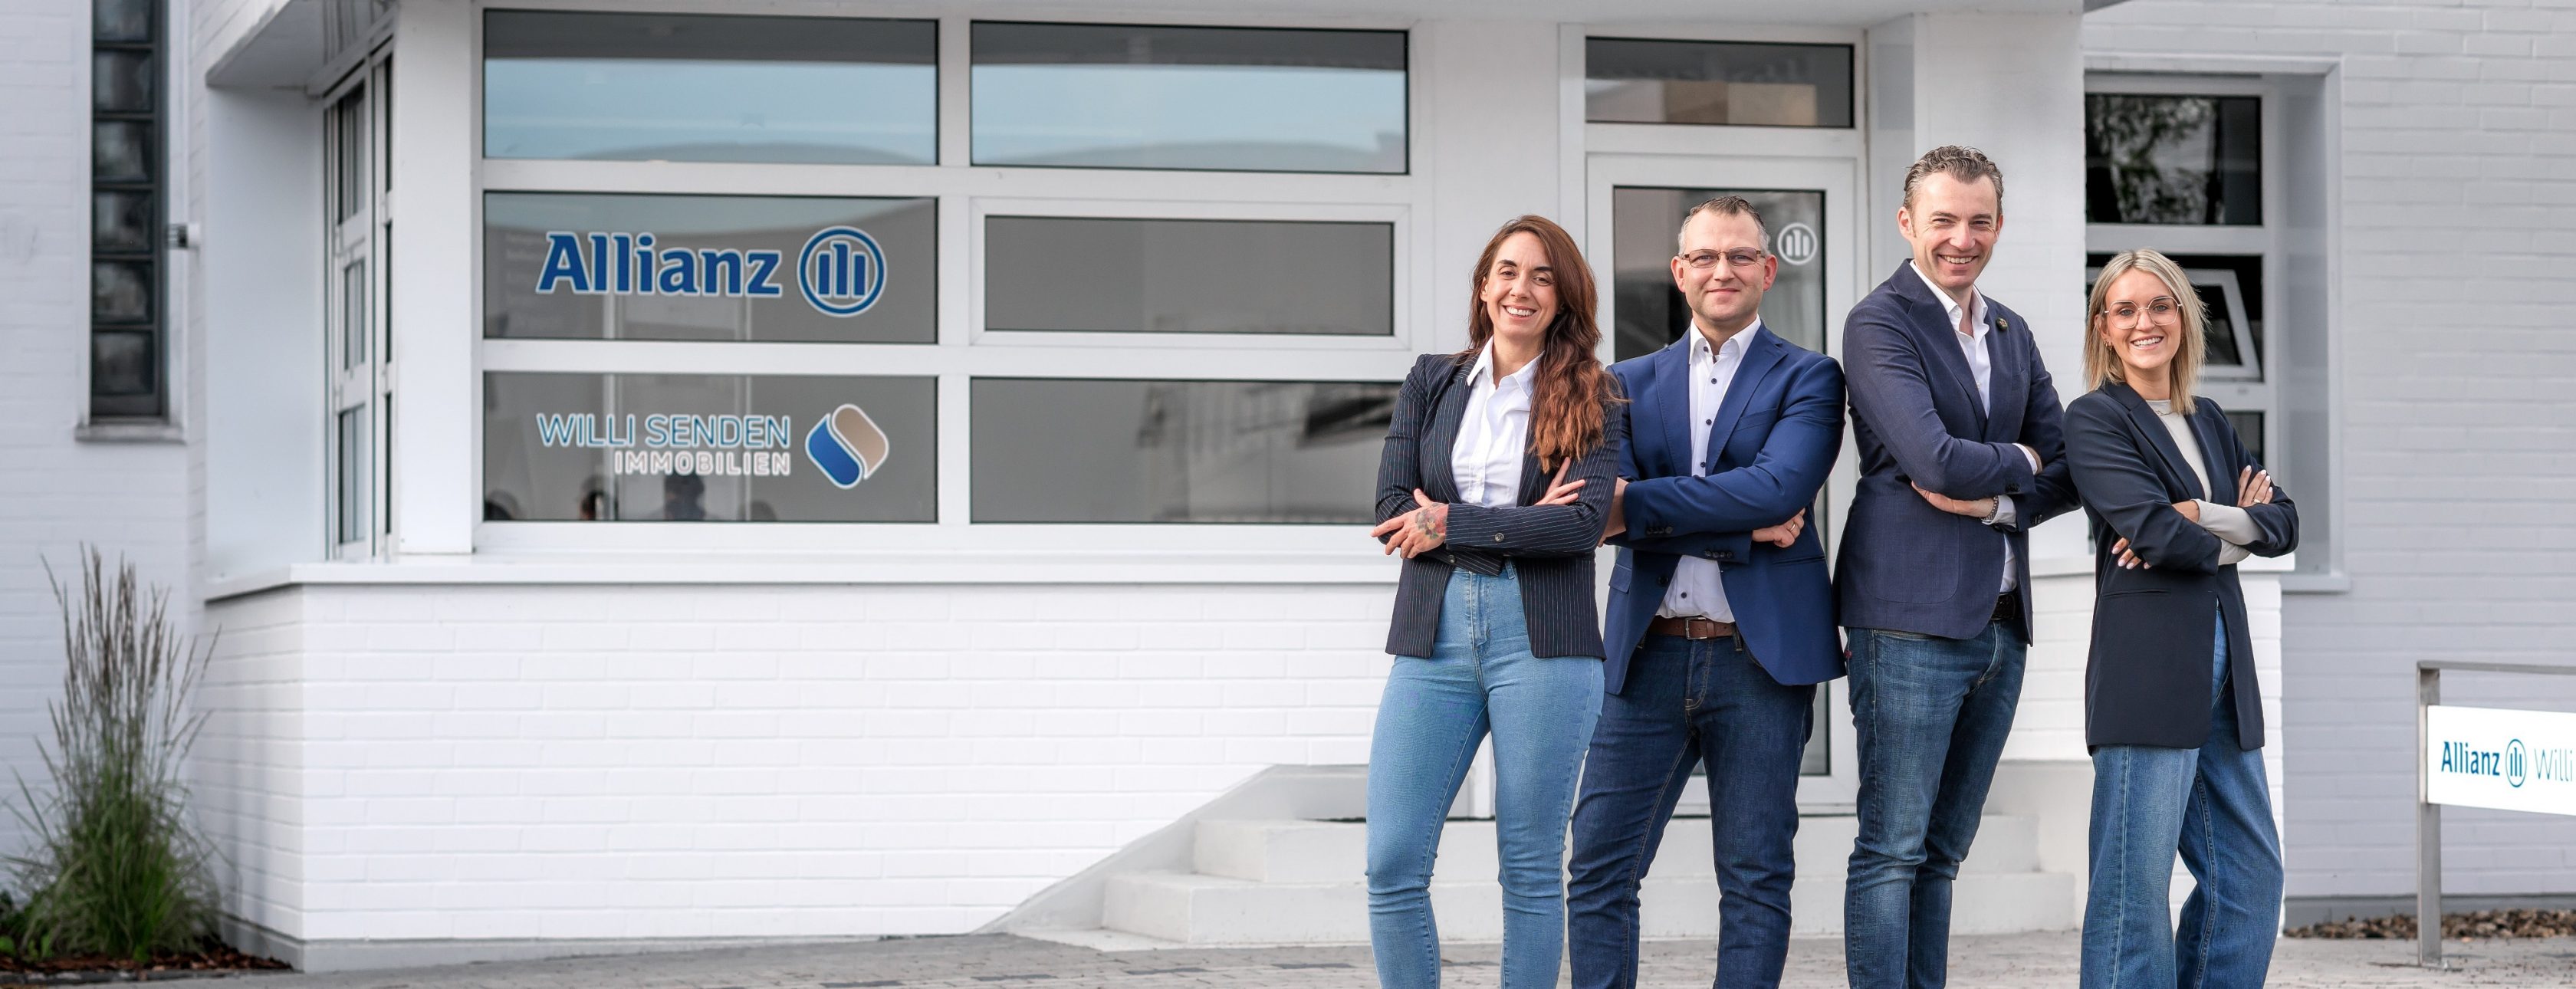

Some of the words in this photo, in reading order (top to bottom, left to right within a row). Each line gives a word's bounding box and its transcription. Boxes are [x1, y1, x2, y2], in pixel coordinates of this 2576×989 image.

[536, 231, 782, 297] Allianz
[537, 413, 635, 449] WILLI
[645, 414, 790, 449] SENDEN
[614, 451, 790, 476] IMMOBILIEN
[2441, 741, 2501, 776] Allianz
[2534, 748, 2574, 782] Willi
